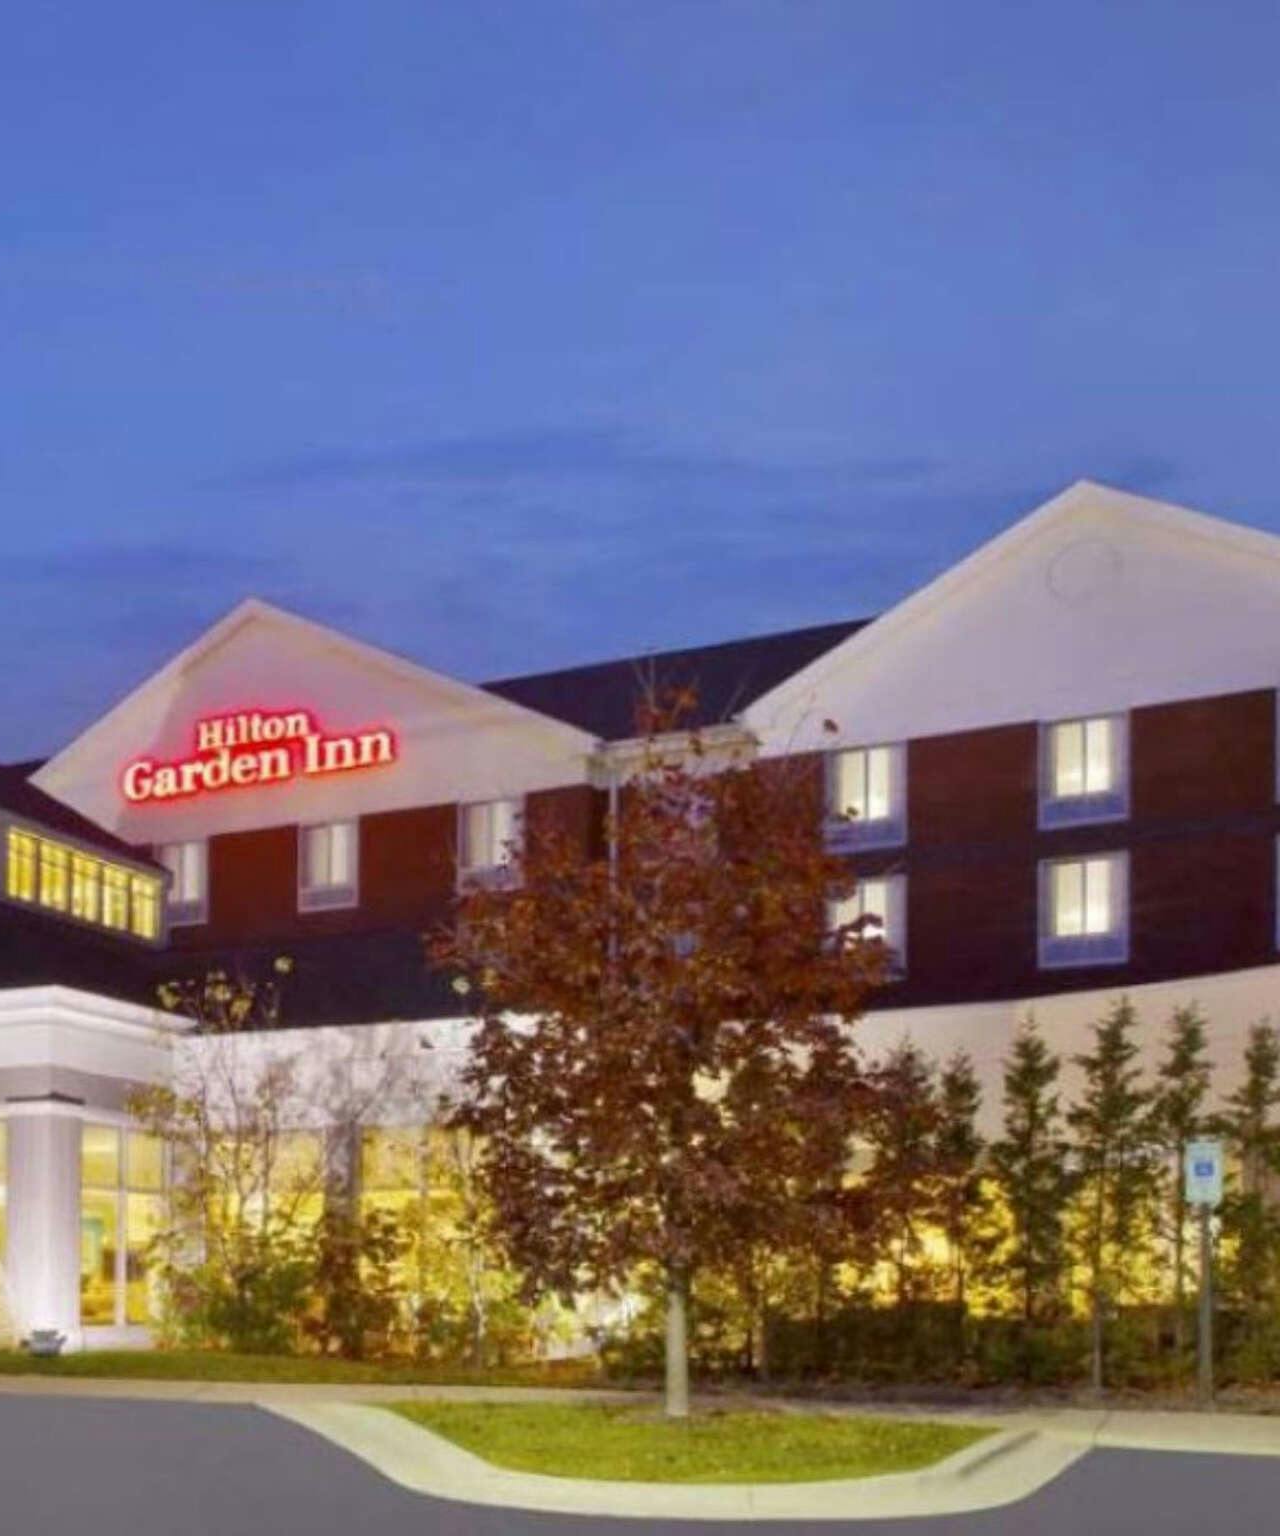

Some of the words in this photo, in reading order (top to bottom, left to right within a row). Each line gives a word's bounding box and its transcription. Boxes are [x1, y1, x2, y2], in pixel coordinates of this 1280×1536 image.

[198, 712, 309, 750] Hilton
[123, 748, 291, 800] Garden
[304, 730, 393, 773] Inn
